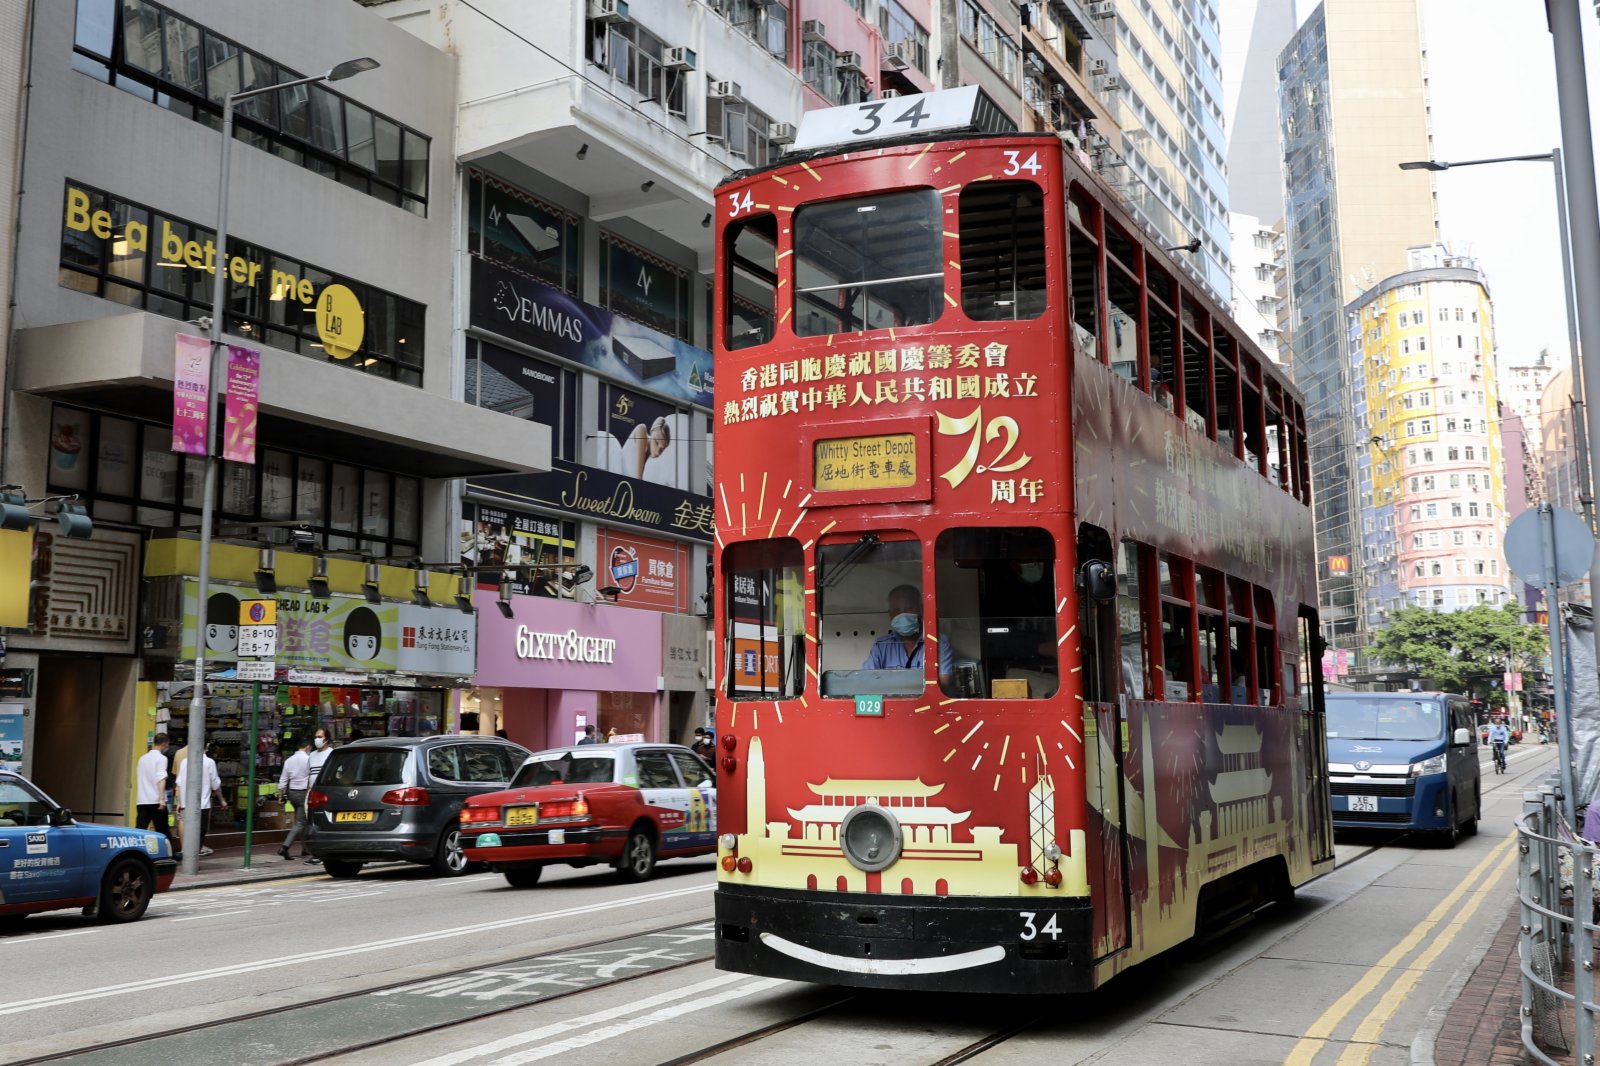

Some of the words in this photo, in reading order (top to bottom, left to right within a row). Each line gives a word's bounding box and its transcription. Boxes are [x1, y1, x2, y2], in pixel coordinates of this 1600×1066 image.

[852, 97, 930, 136] 34
[1003, 150, 1042, 176] 34
[729, 192, 754, 218] 34
[66, 188, 112, 240] Be
[125, 219, 148, 252] a
[272, 266, 315, 305] me
[326, 294, 333, 312] B
[325, 313, 343, 337] LAB
[740, 341, 1008, 393] 香港同胞慶祝國慶籌委會
[723, 372, 1038, 425] 熱烈祝賀中華人民共和國成立
[819, 442, 849, 462] Whitty
[852, 438, 881, 458] Street
[885, 437, 914, 456] Depot
[935, 404, 1032, 489] 72
[820, 459, 914, 481] 屈地街電車廠
[561, 471, 612, 515] Sweet
[610, 481, 662, 525] Dream
[991, 478, 1044, 504] 周年
[252, 629, 274, 638] 8-10
[418, 626, 468, 643] 東方文具公司
[516, 624, 616, 664] 6IXTY8IGHT
[859, 701, 881, 713] 029
[1352, 803, 1375, 811] 2213
[1357, 796, 1369, 804] XE
[352, 812, 368, 820] 409
[28, 834, 46, 844] SAXO
[1019, 912, 1063, 941] 34
